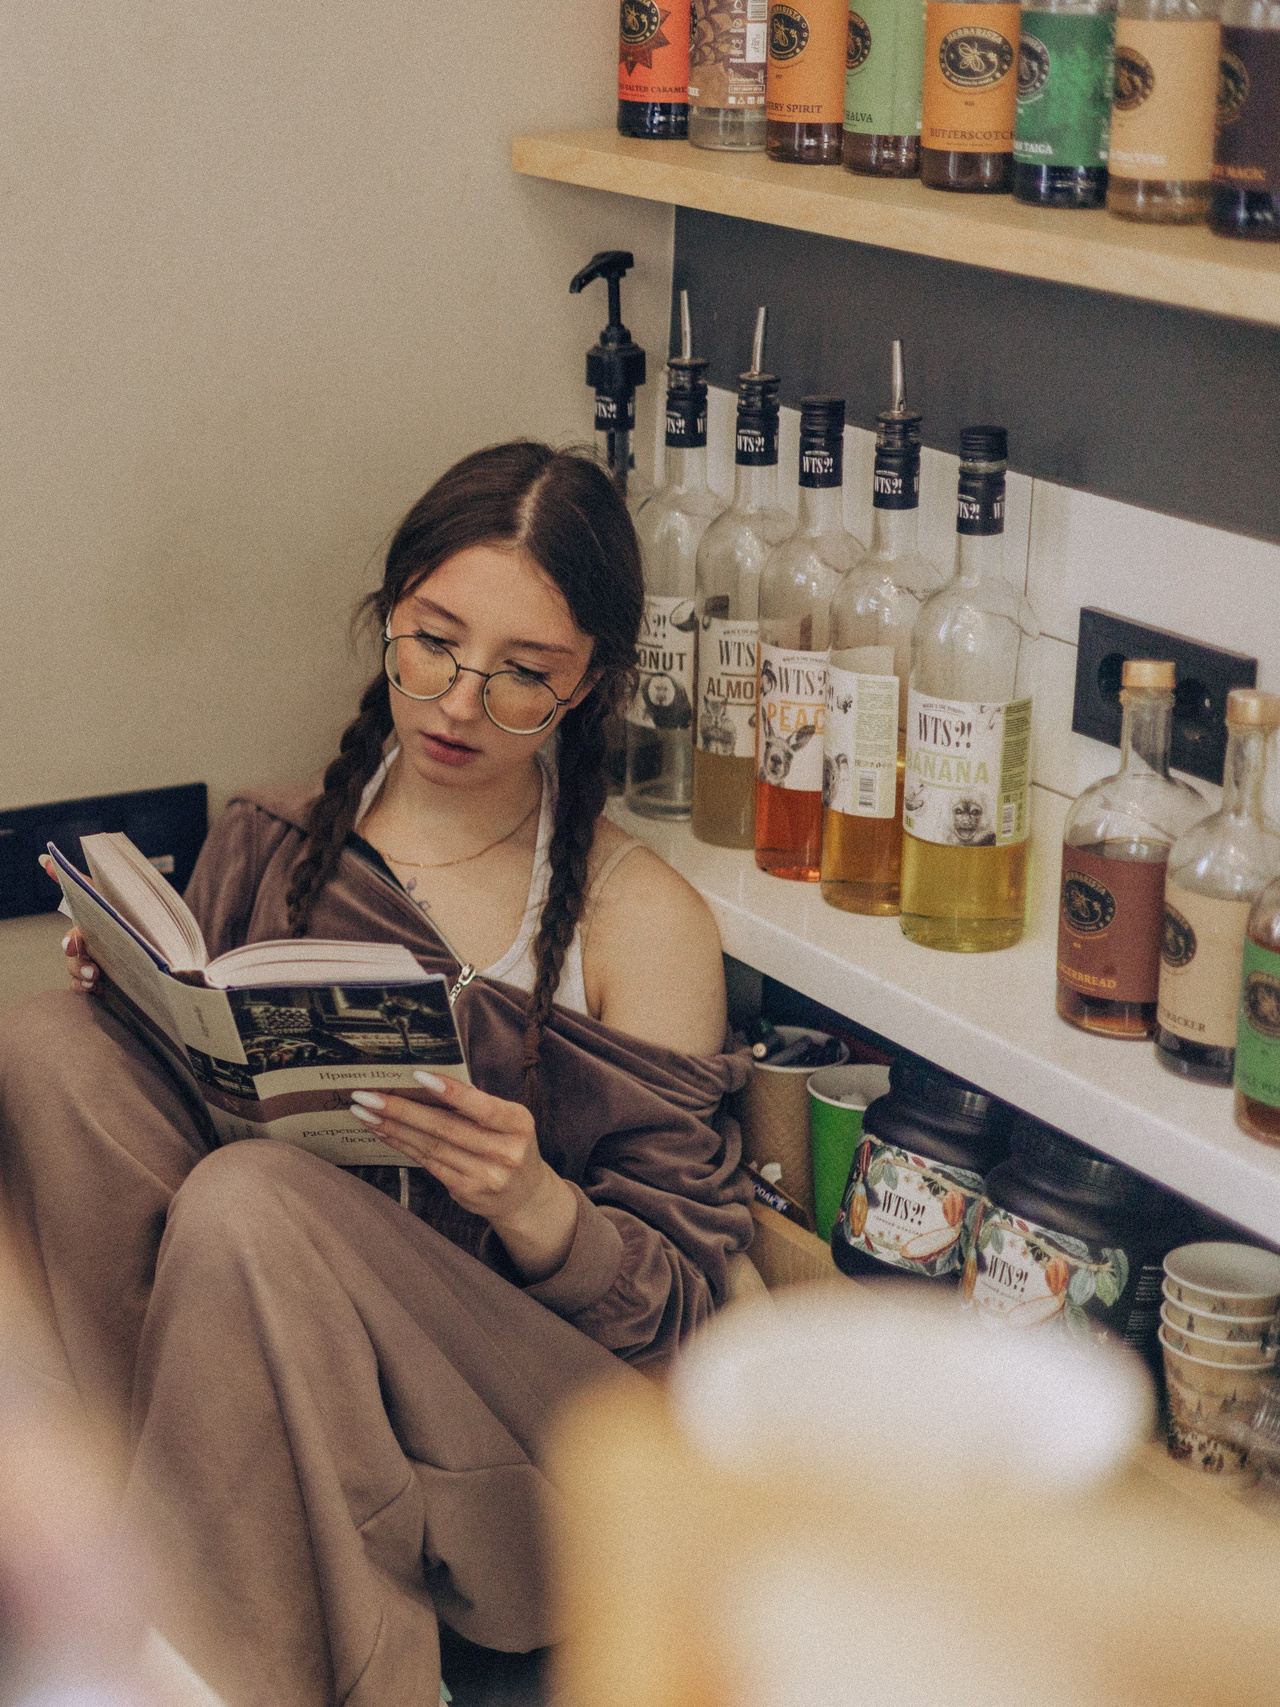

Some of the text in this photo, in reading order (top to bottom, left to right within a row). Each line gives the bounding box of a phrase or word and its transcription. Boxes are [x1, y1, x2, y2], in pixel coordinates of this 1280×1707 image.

[946, 27, 1003, 44] HERBARISTA
[786, 103, 823, 114] SPIRIT
[803, 456, 834, 474] WTS?!
[918, 712, 972, 749] WTS?!
[319, 1070, 403, 1081] Ирвин Шоу
[340, 1136, 376, 1144] Люси
[881, 1190, 926, 1226] WTS?!
[988, 1254, 1029, 1292] WTS?!
